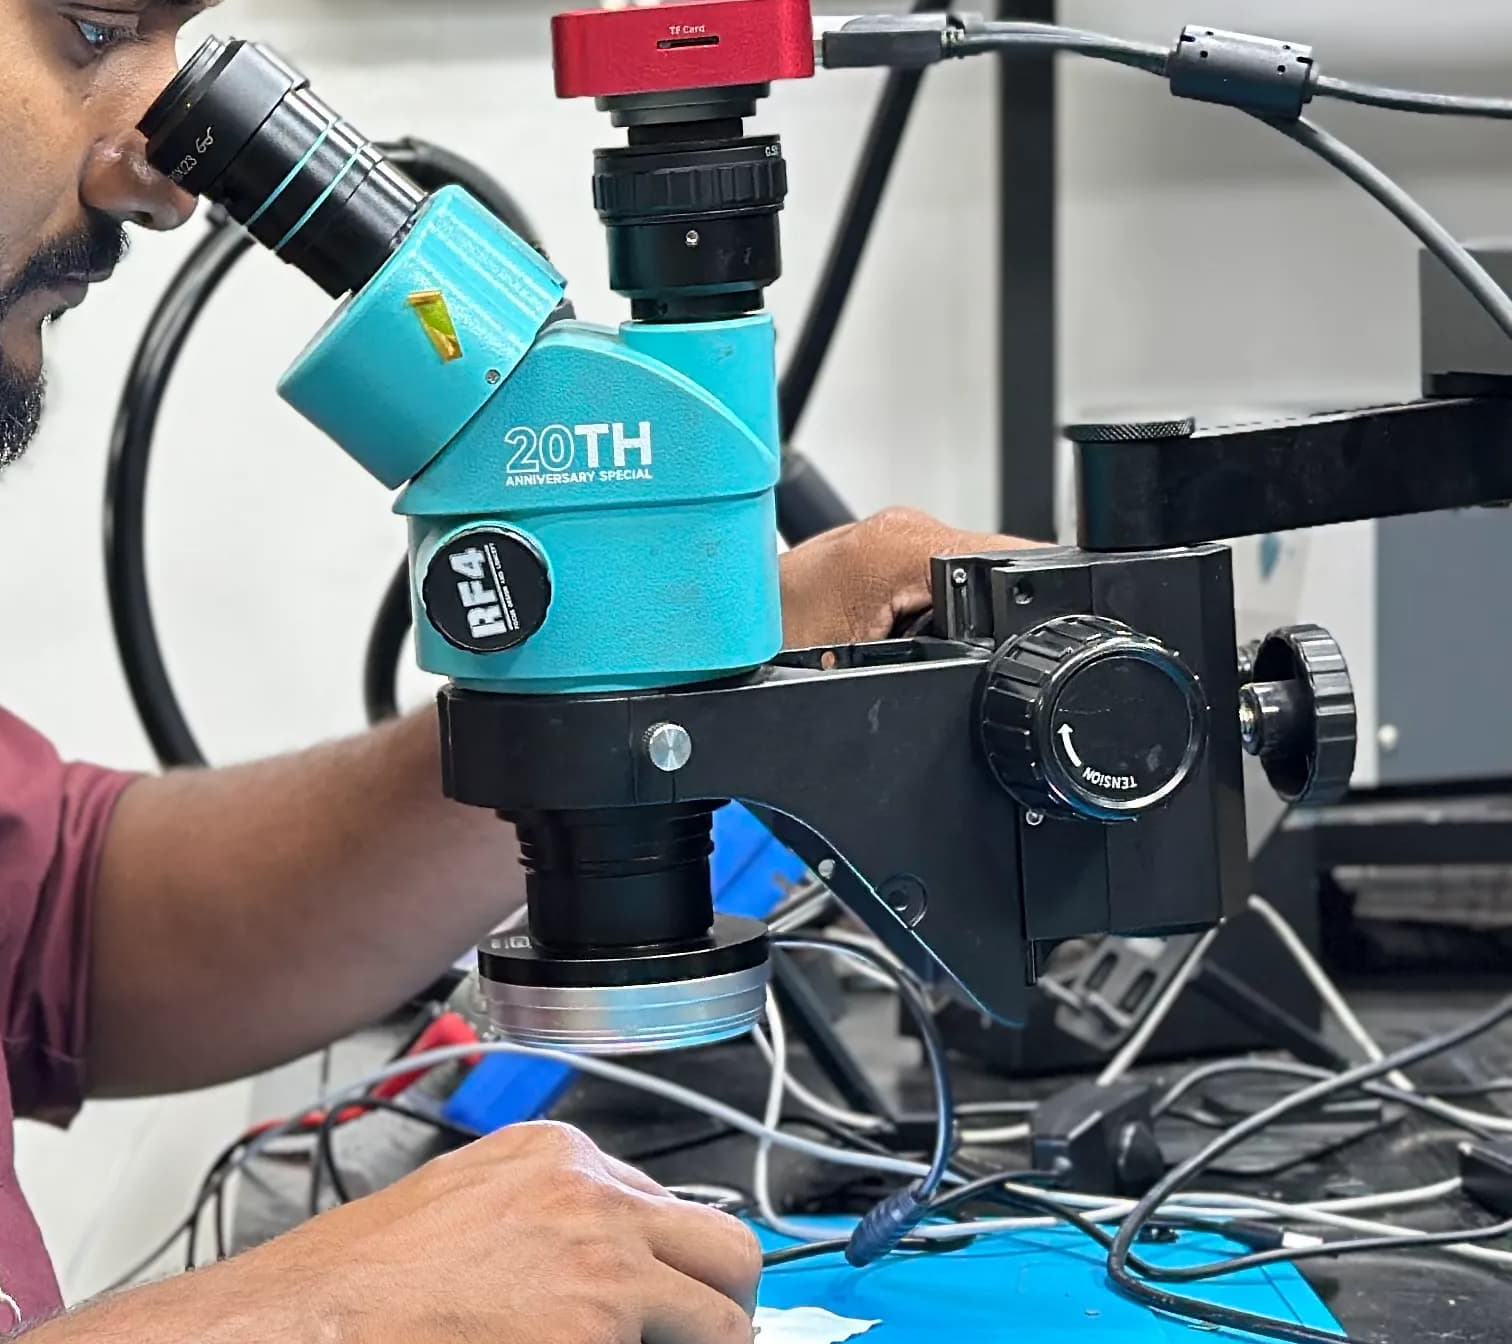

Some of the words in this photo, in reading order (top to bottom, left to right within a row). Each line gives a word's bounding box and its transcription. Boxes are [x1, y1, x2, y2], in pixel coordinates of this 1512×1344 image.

[667, 24, 680, 35] TF
[681, 23, 705, 34] Card
[504, 422, 652, 472] 20TH
[506, 471, 595, 487] ANNIVERSARY
[599, 468, 652, 482] SPECIAL
[1082, 766, 1138, 790] TENSION
